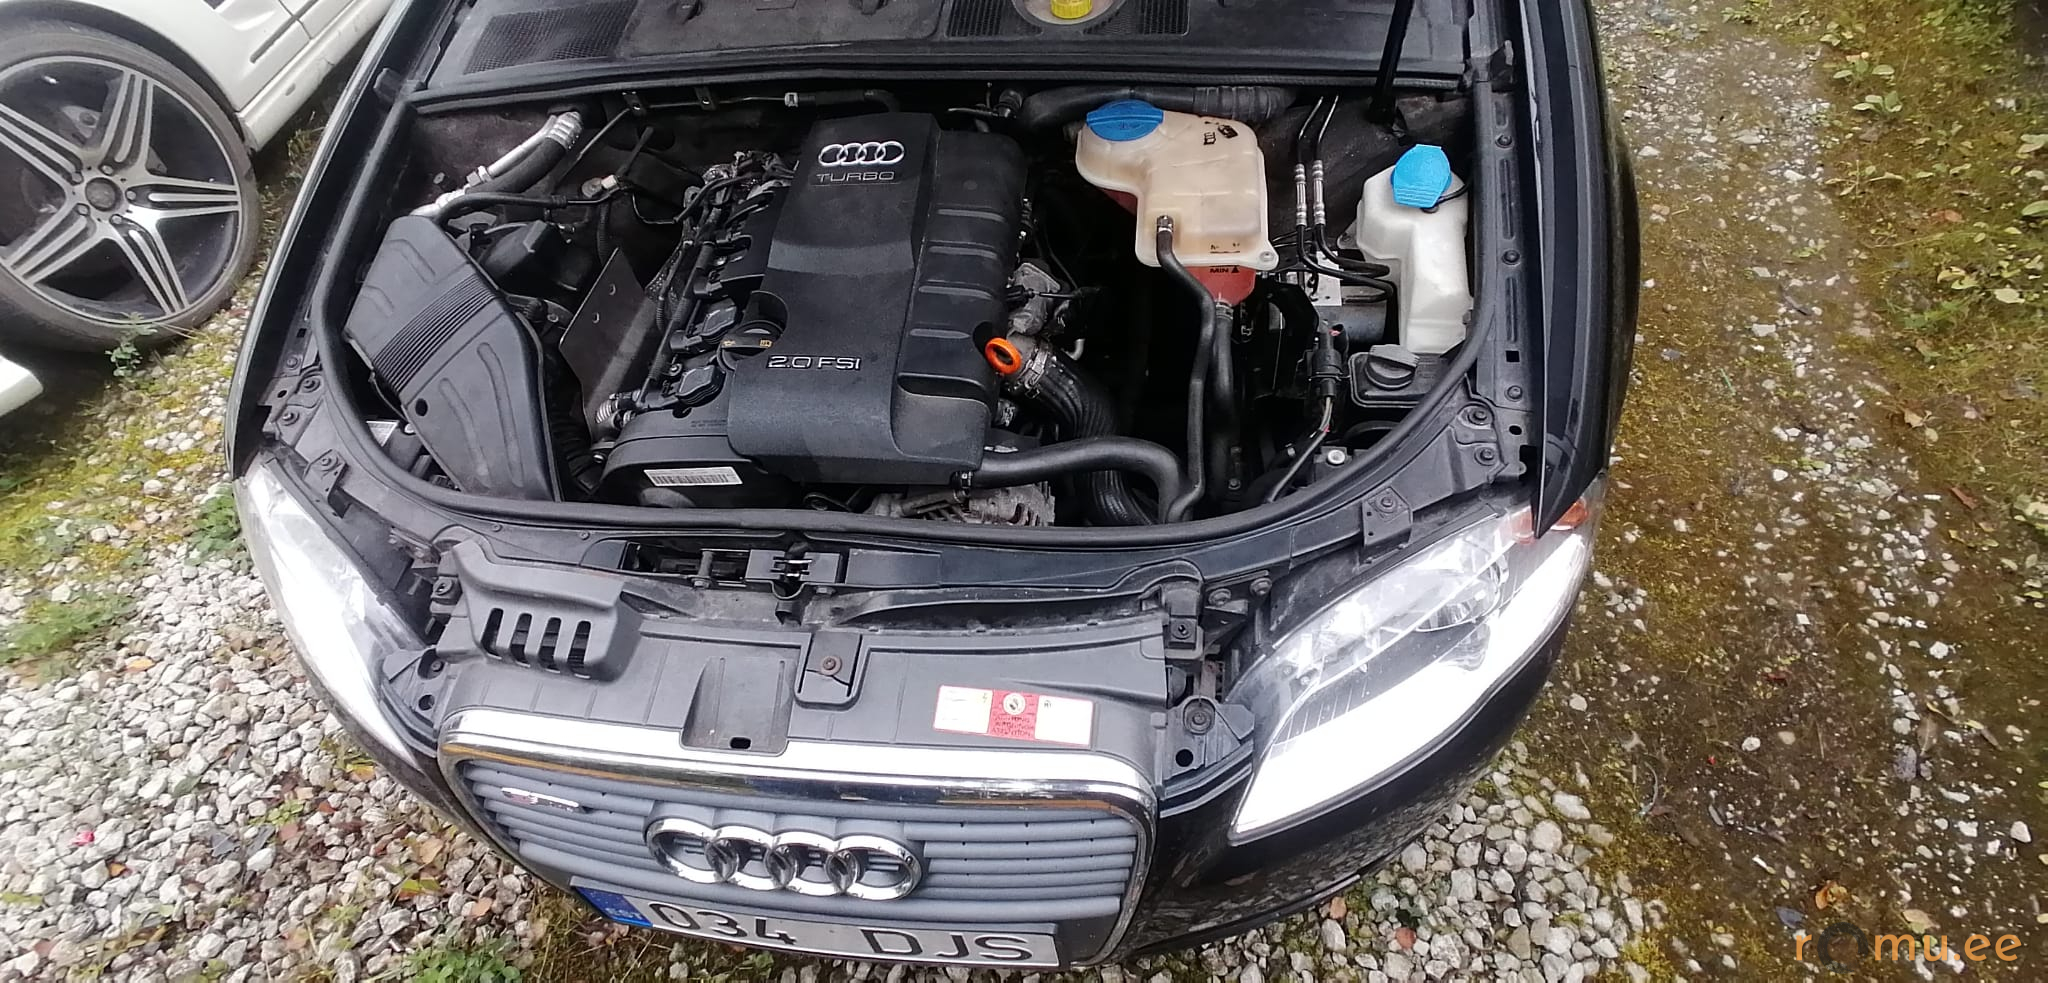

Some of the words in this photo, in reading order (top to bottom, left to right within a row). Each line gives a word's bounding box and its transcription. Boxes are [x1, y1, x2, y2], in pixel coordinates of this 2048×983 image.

[816, 172, 894, 182] TURBO
[768, 356, 812, 369] 2.0
[817, 357, 861, 370] FSI
[606, 907, 643, 920] EST
[649, 902, 798, 945] 034
[860, 928, 1033, 961] DJS
